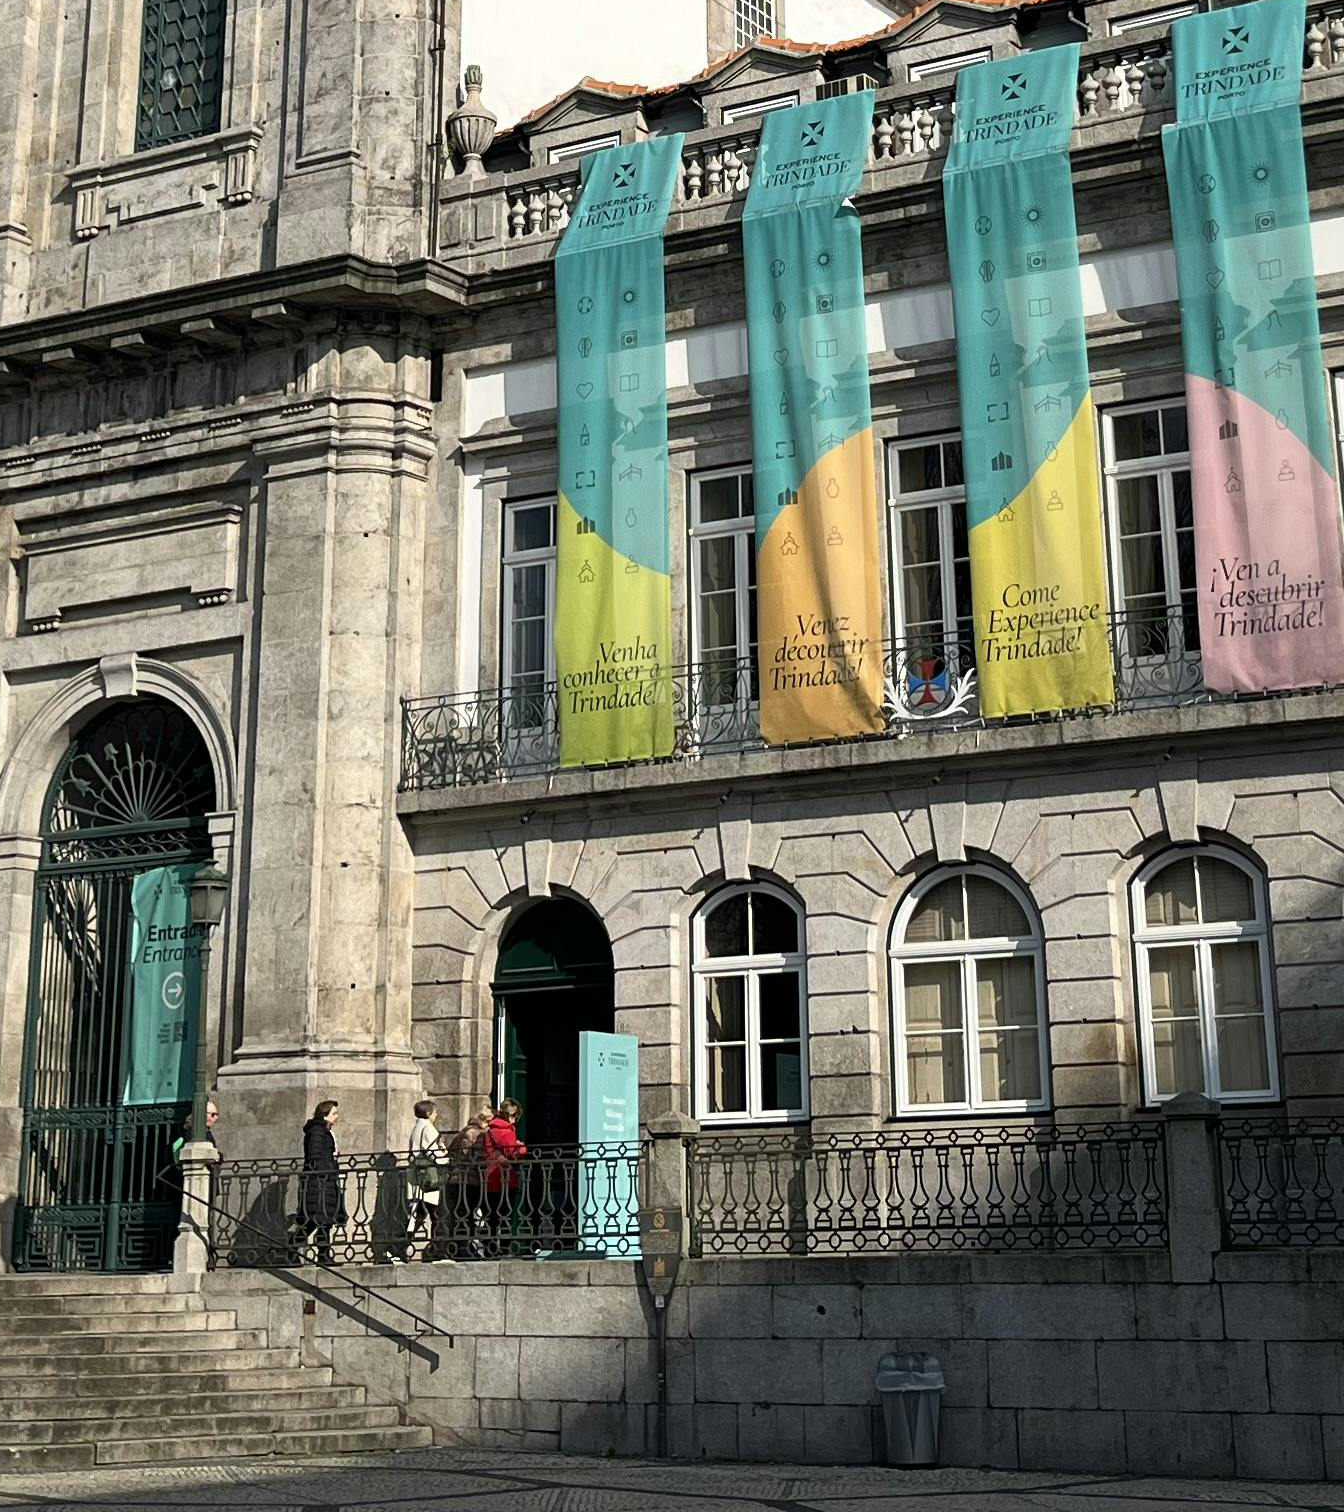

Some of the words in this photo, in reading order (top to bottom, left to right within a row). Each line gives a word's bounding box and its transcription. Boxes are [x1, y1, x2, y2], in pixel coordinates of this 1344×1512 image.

[1181, 66, 1285, 98] TRINDADE
[1196, 58, 1272, 80] EXPERIENCE
[1217, 91, 1246, 100] PORTO
[963, 112, 1057, 143] TRINDADE
[976, 104, 1046, 125] EXPERIENCE
[765, 160, 851, 188] TRINDADE
[776, 152, 841, 171] EXPERIENCE
[577, 199, 658, 228] TRINDADE
[589, 193, 649, 212] EXPERIENCE
[1210, 557, 1260, 592] ¡Ven
[1267, 559, 1280, 577] a
[1003, 584, 1060, 608] Come
[1219, 573, 1325, 608] descubrir
[797, 614, 850, 637] Venez
[988, 603, 1100, 640] Experience
[1215, 600, 1324, 636] Trindade!
[600, 635, 657, 663] Venha
[774, 632, 869, 663] découvrir
[982, 627, 1082, 662] Trindade!
[563, 660, 644, 688] conhecer
[649, 663, 660, 678] a
[770, 658, 863, 691] Trindade!
[569, 680, 657, 713] Trindade!
[147, 925, 203, 942] Entrad
[142, 945, 201, 964] Entranc
